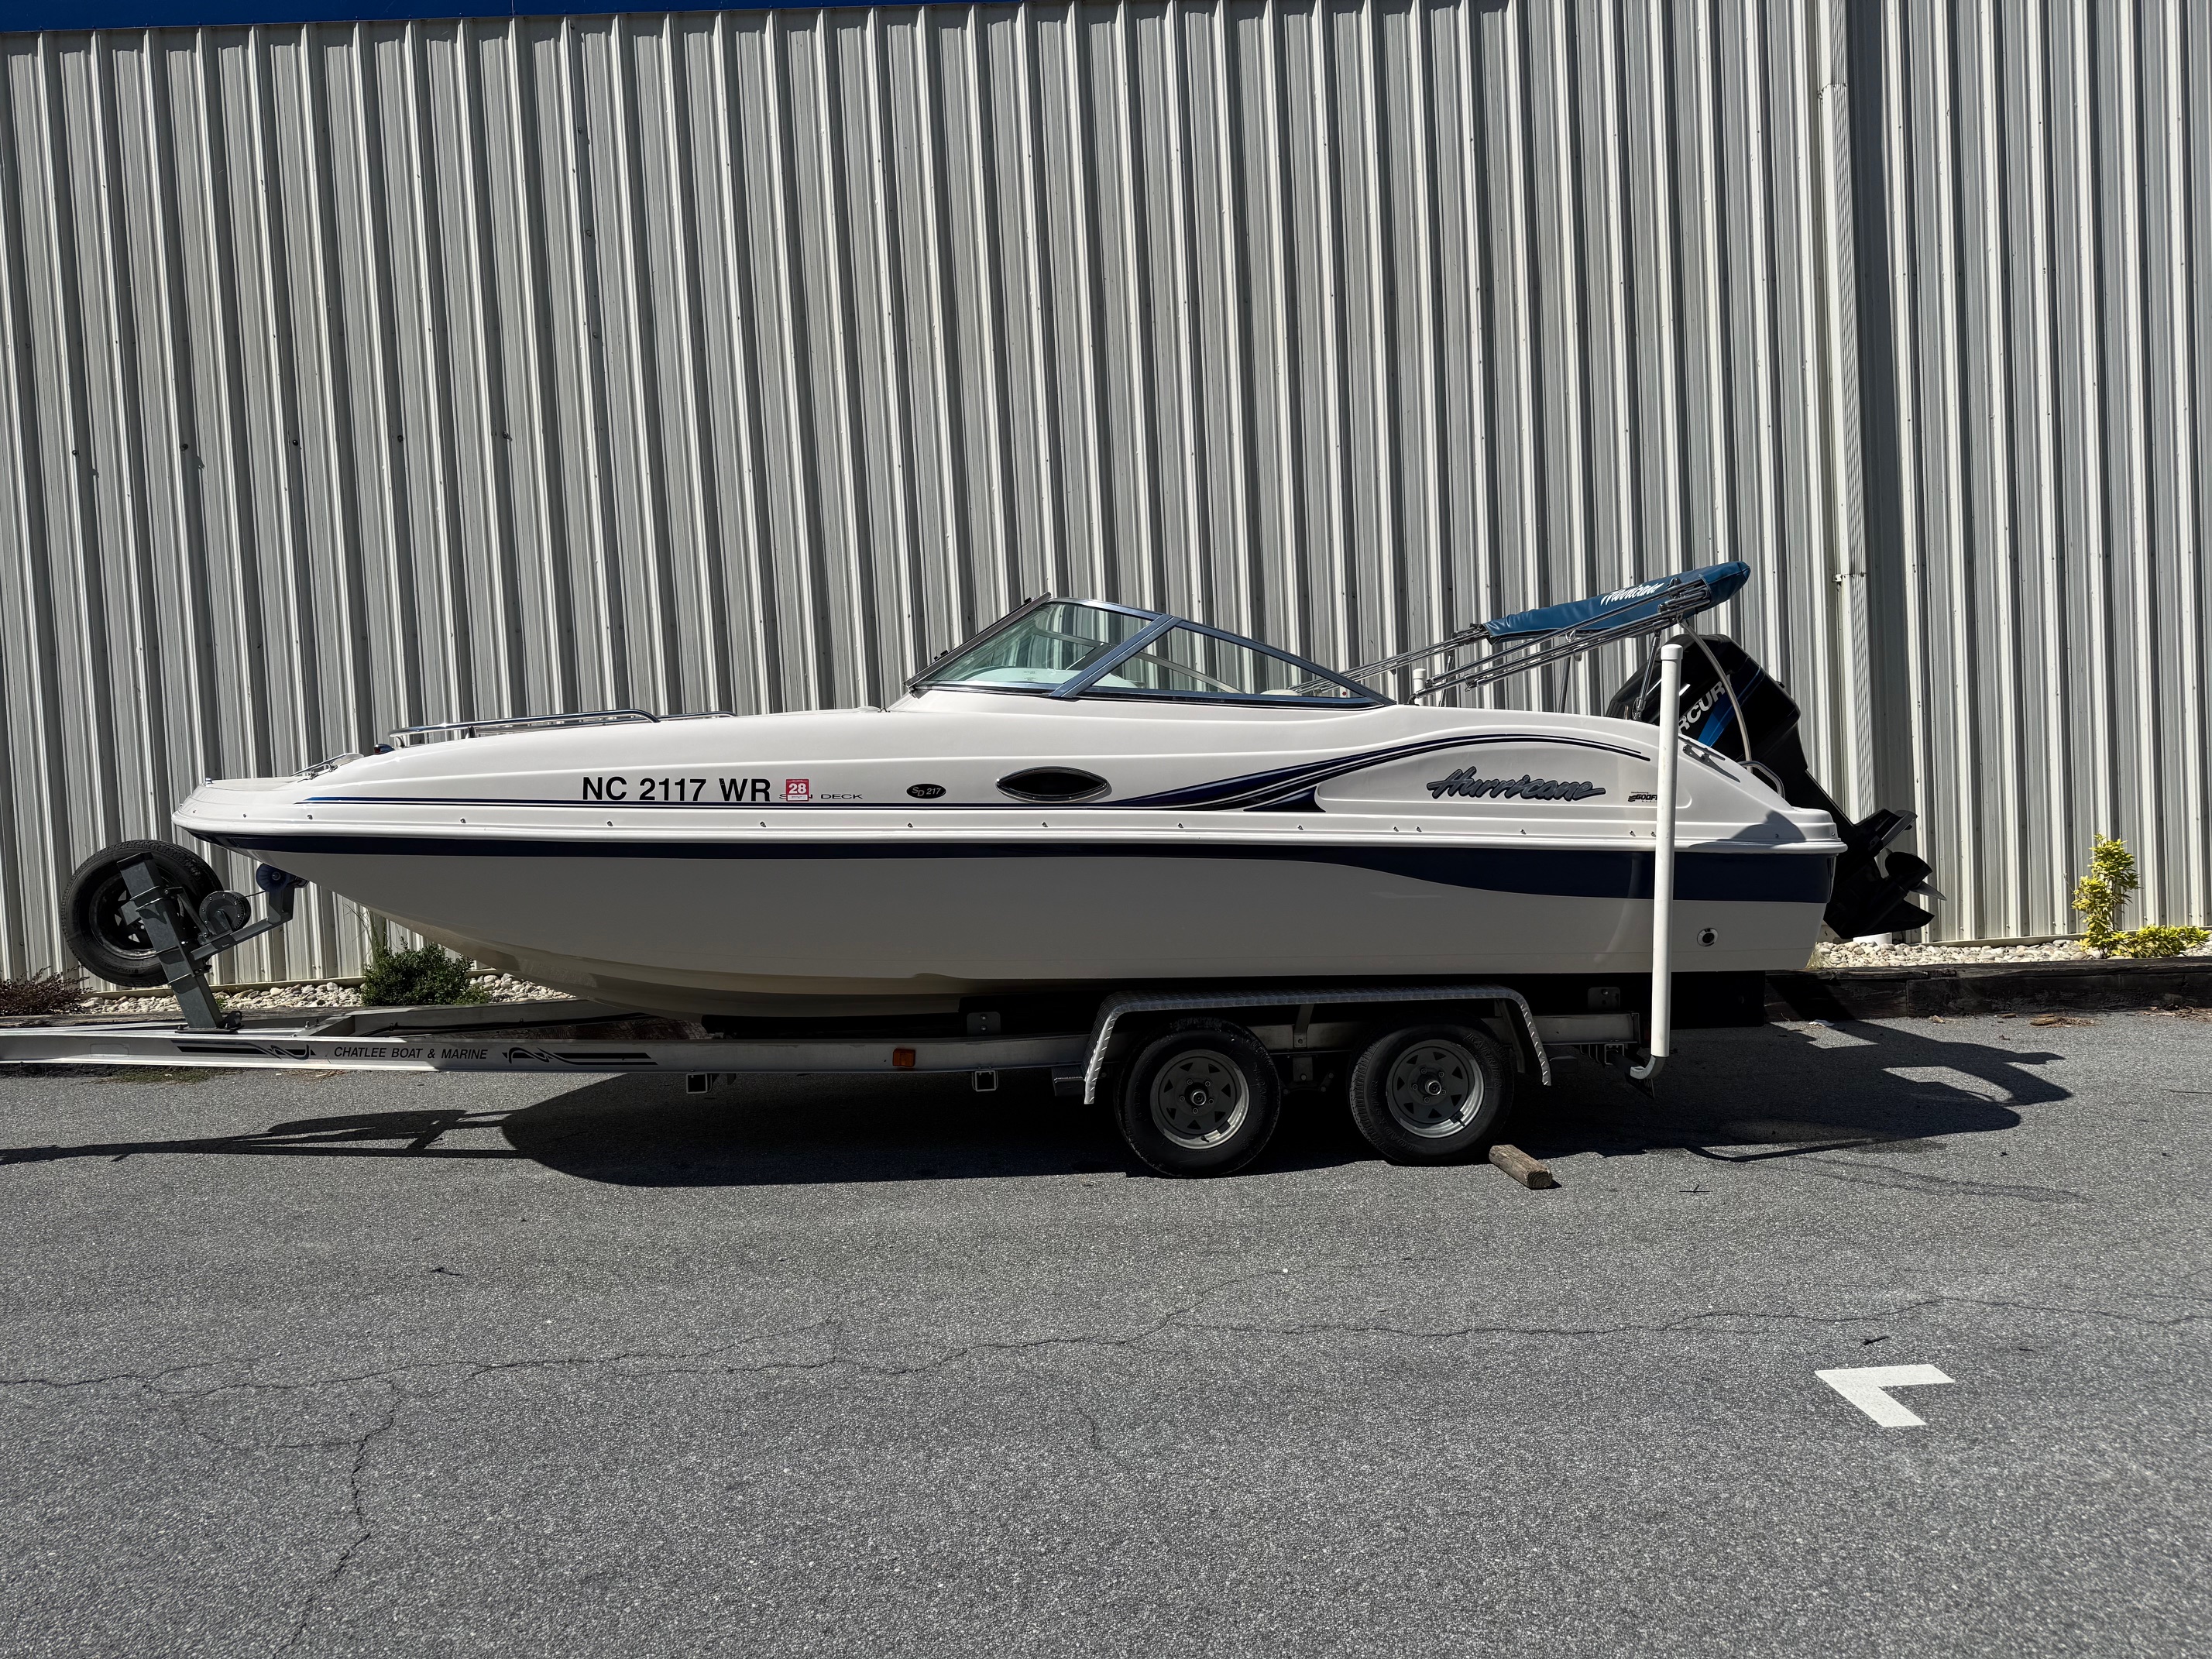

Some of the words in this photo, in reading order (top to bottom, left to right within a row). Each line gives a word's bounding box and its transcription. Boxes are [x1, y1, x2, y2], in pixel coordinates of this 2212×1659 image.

[582, 776, 627, 801] NC
[639, 778, 707, 802] 2117
[719, 778, 771, 802] WR
[788, 782, 807, 794] 28
[1427, 766, 1606, 802] Hurricane
[334, 1046, 386, 1058] CHATLEE
[391, 1048, 423, 1058] BOAT
[427, 1049, 435, 1059] &
[441, 1049, 489, 1060] MARINE
